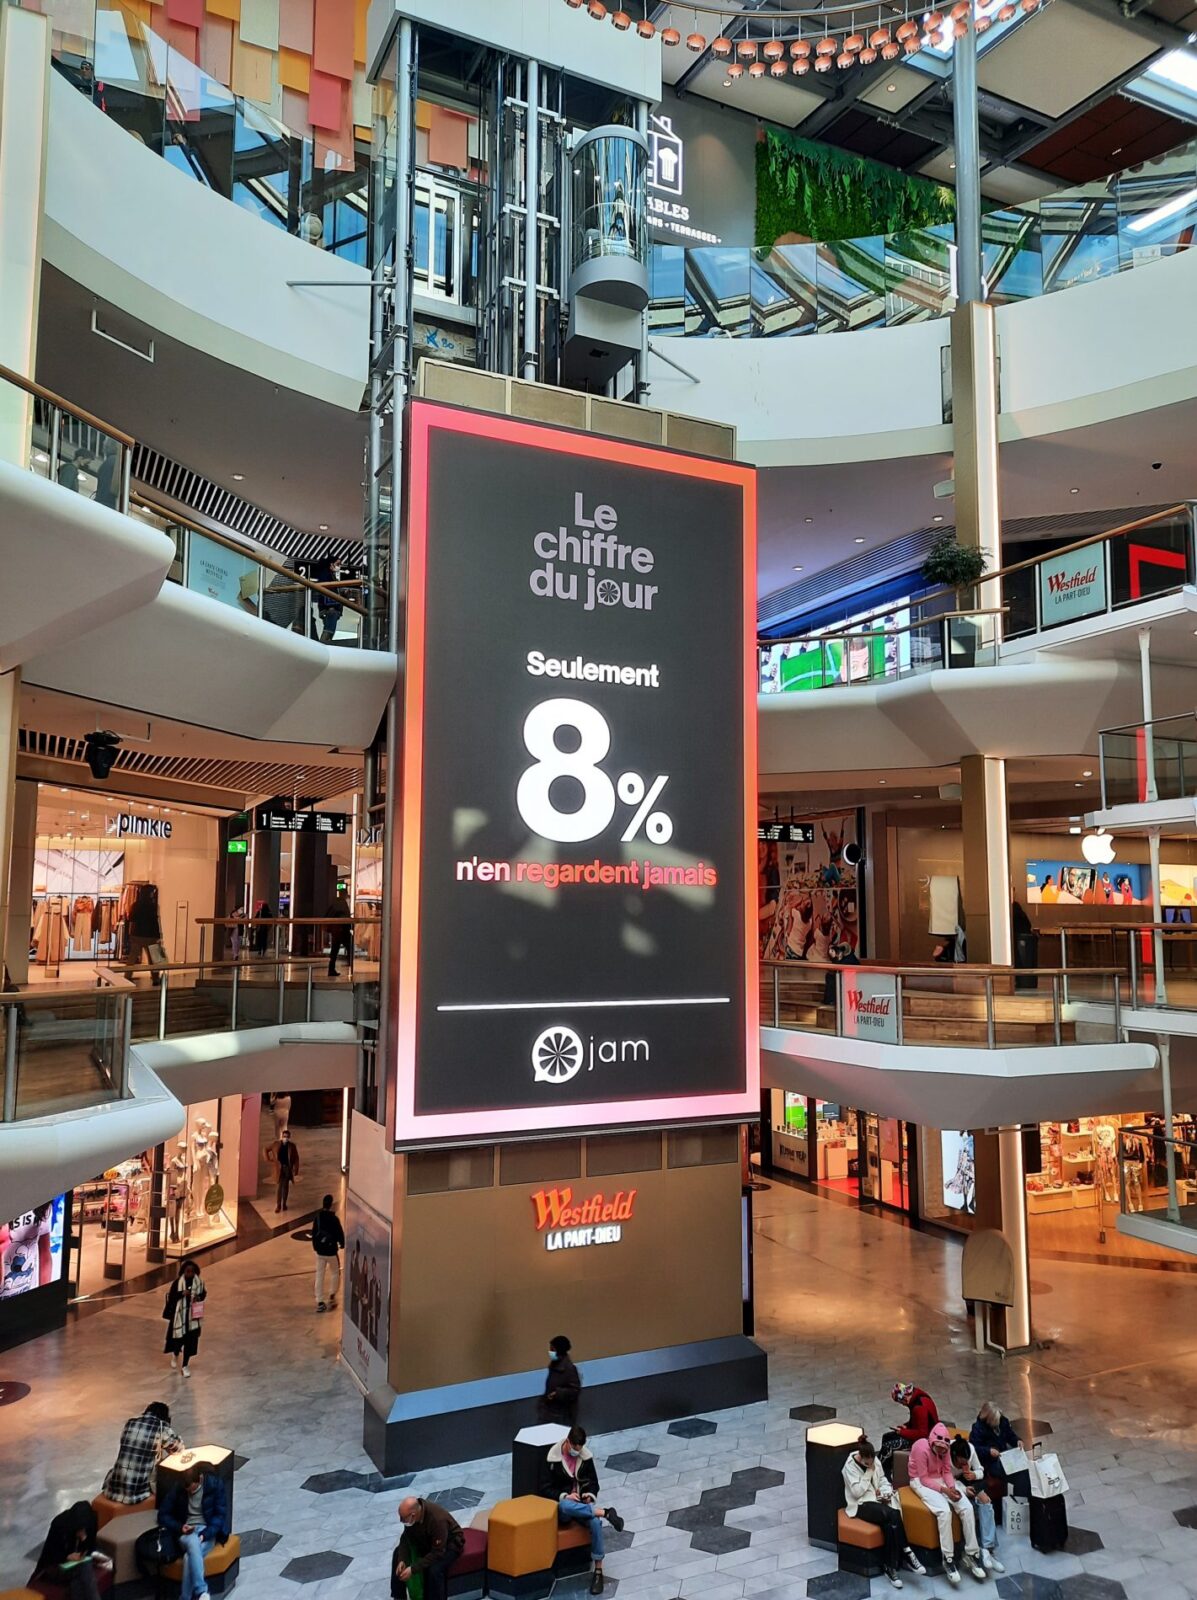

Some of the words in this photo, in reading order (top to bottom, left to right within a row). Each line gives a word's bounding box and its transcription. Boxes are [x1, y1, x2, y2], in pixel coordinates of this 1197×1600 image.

[647, 196, 689, 220] ABLES
[575, 492, 618, 531] Le
[533, 526, 655, 574] chiffre
[299, 566, 306, 579] 2
[529, 562, 578, 600] du
[584, 568, 658, 610] jour
[1047, 565, 1098, 595] Westfield
[1055, 595, 1062, 604] LA
[527, 651, 660, 688] Seulement
[516, 697, 674, 845] 8%
[116, 813, 172, 838] pimkie
[262, 813, 267, 826] 1
[456, 856, 511, 881] n'en
[516, 860, 639, 888] regardent
[641, 860, 717, 889] jamais
[847, 990, 891, 1015] Westfield
[854, 1015, 860, 1024] LA
[588, 1035, 650, 1071] jam
[531, 1187, 637, 1230] Westfield
[546, 1232, 563, 1250] LA
[563, 1225, 621, 1248] PART-DIEU
